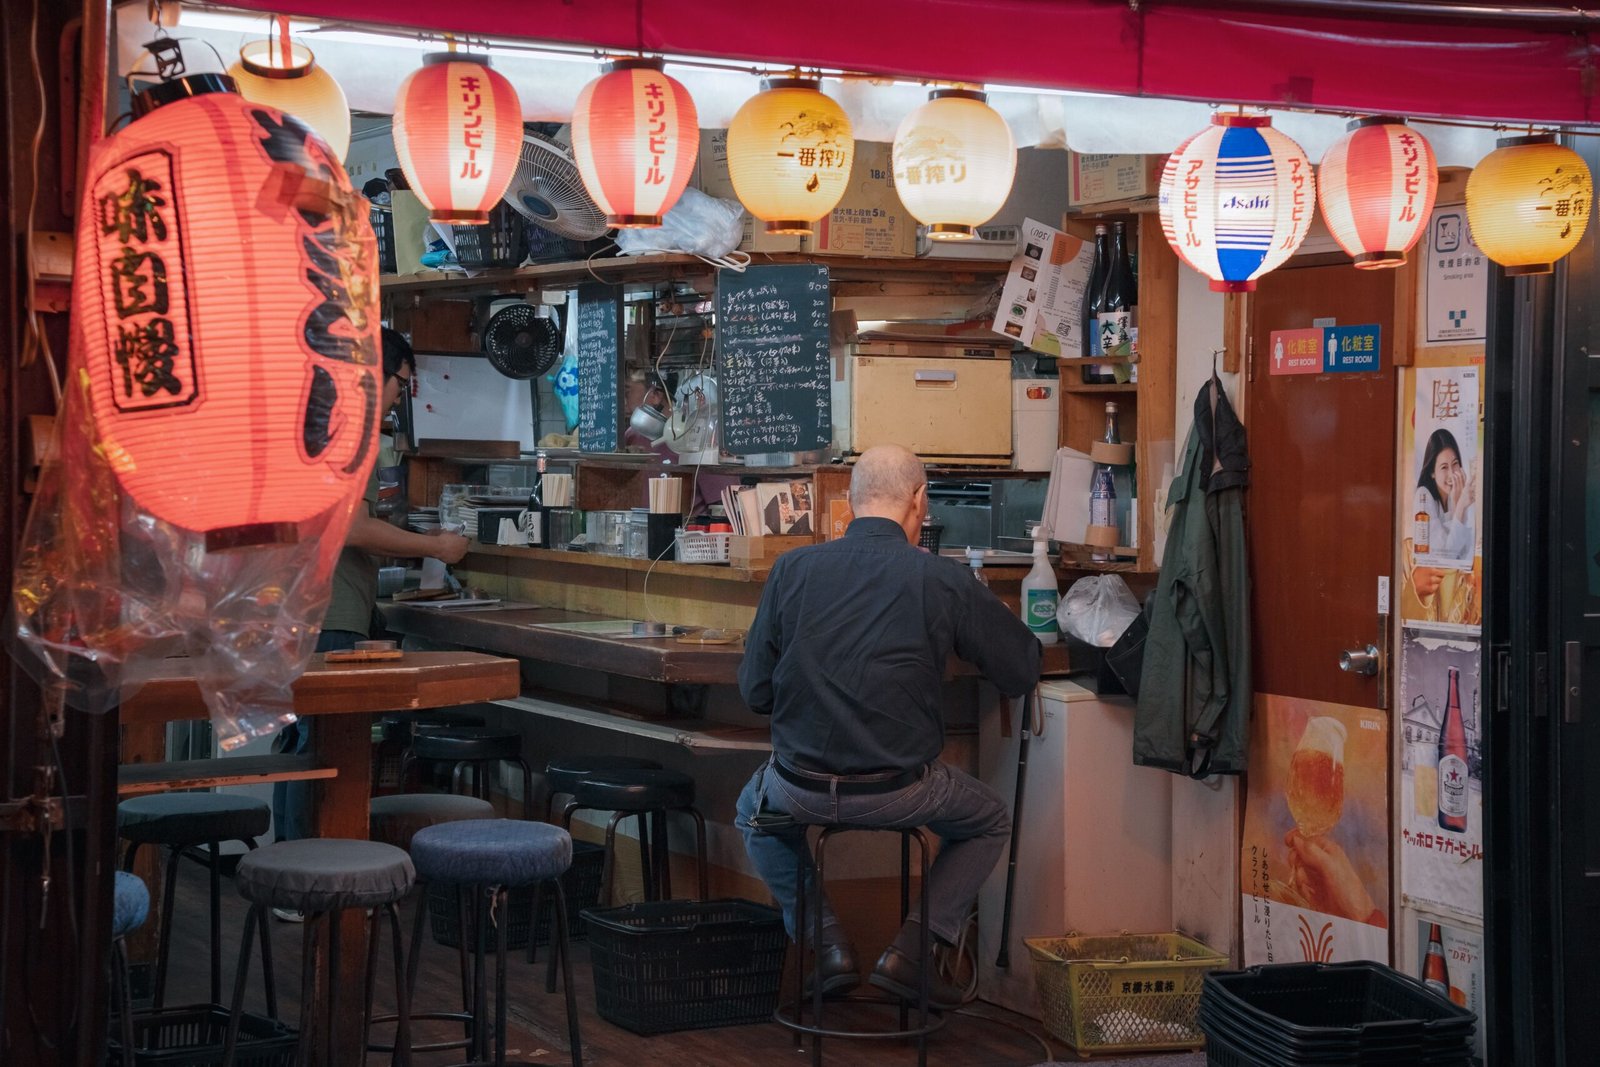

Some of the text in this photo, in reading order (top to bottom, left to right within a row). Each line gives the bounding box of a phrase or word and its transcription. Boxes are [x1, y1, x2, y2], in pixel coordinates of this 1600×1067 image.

[459, 76, 482, 180] キリンビール
[644, 82, 666, 186] キリンビール
[777, 147, 846, 168] 一番搾り
[896, 163, 967, 186] 一番搾り
[1398, 133, 1422, 223] キリンビール
[1183, 159, 1204, 248] アサヒビール
[1223, 195, 1270, 209] Asahi
[1280, 158, 1305, 250] アサヒビール
[1102, 319, 1115, 352] 大辛
[1287, 338, 1318, 355] 化粧室
[1341, 334, 1374, 352] 化粧室
[1288, 357, 1317, 367] REST ROOM
[1342, 355, 1373, 364] REST ROOM
[1431, 378, 1461, 420] 陸
[1360, 719, 1381, 732] KIRIN
[1403, 828, 1480, 860] サッポロ ラガービール
[1251, 845, 1261, 924] クラフトビール
[1261, 847, 1274, 962] しあわせに浸りたい日
